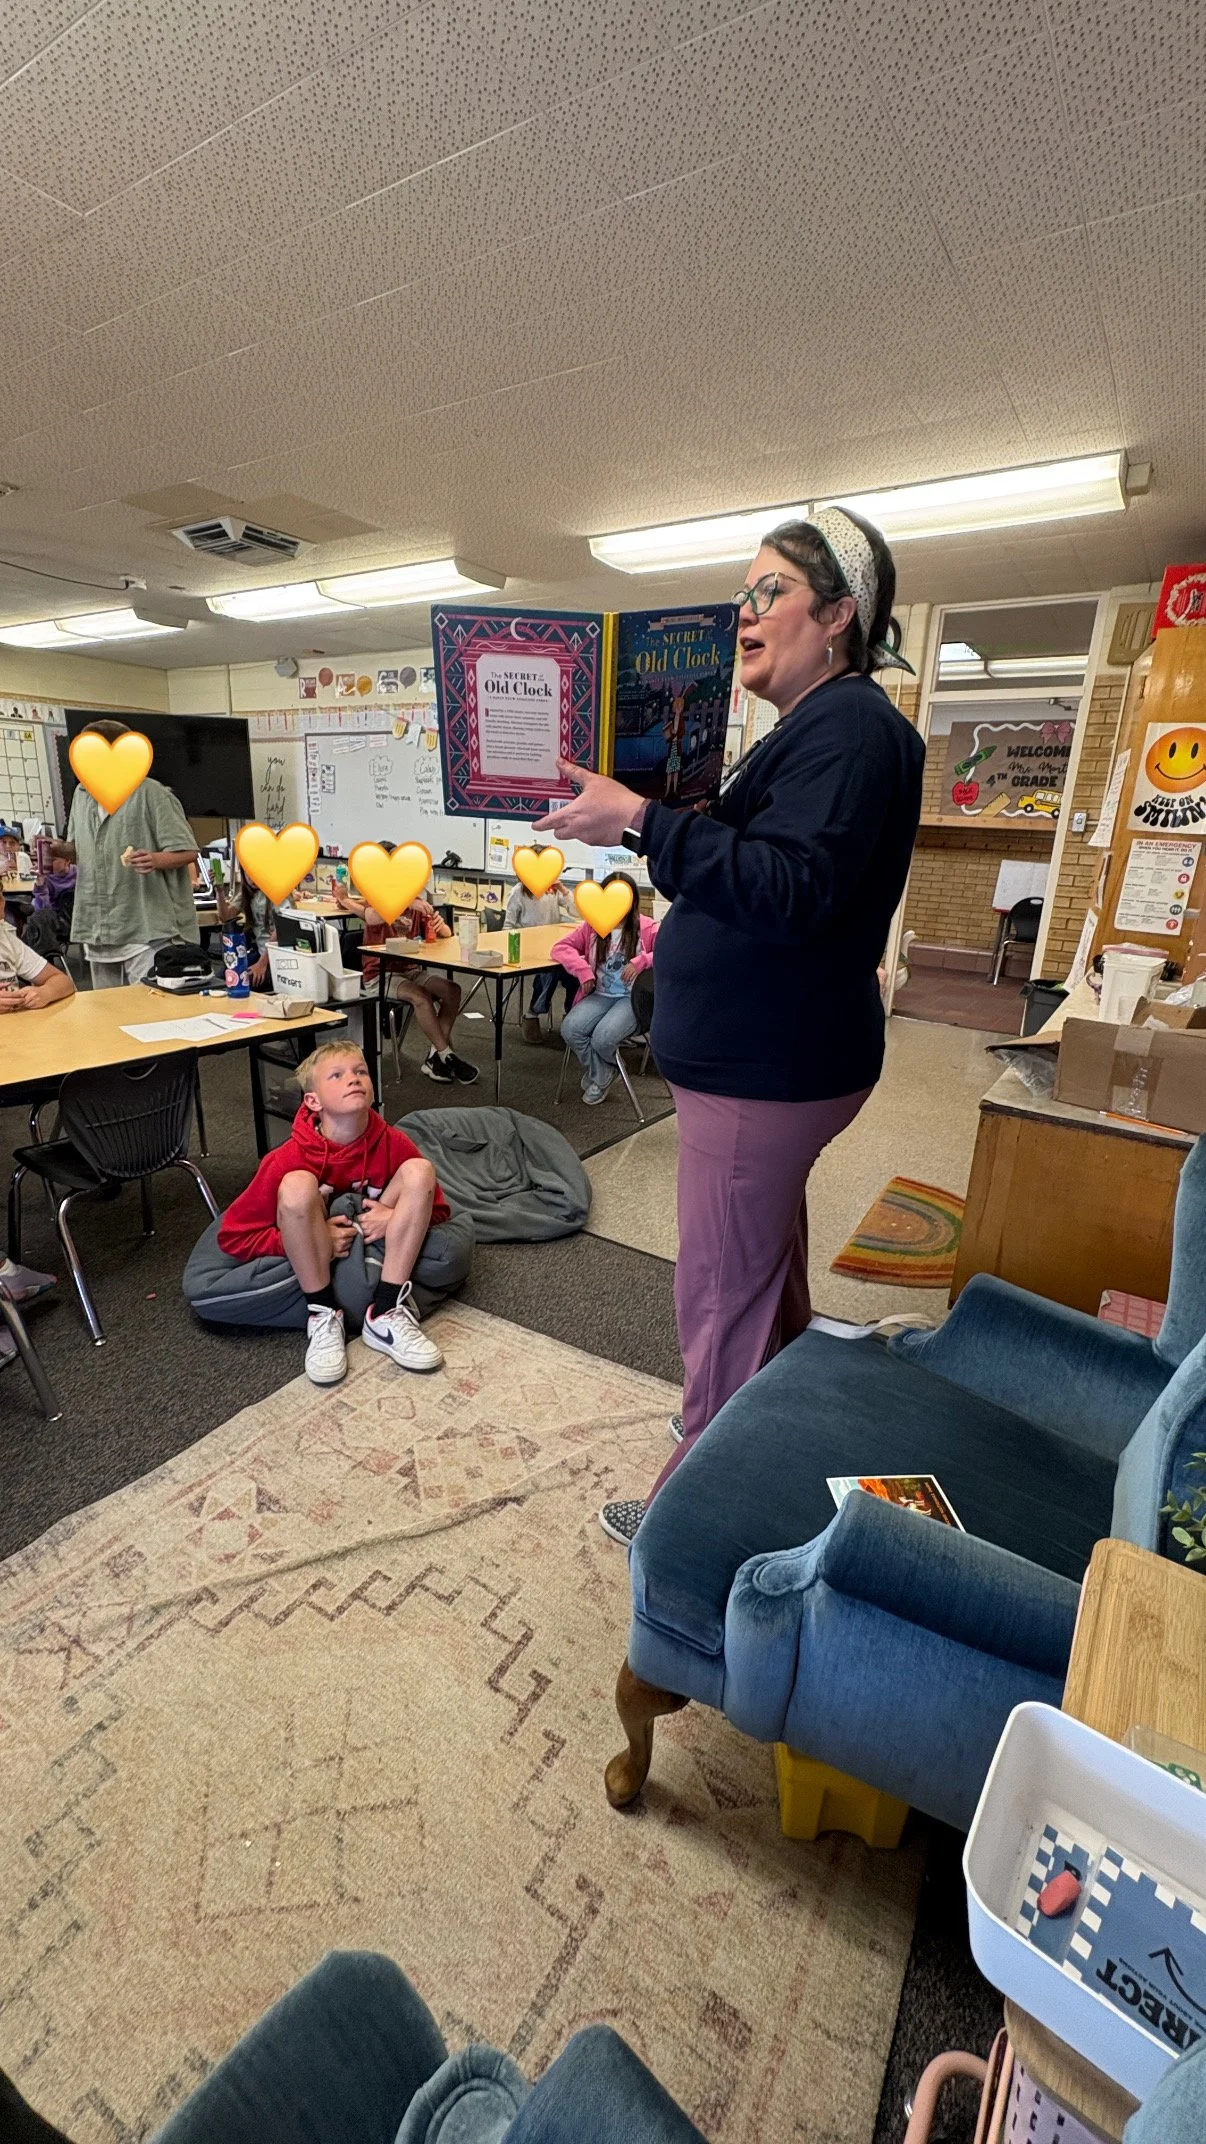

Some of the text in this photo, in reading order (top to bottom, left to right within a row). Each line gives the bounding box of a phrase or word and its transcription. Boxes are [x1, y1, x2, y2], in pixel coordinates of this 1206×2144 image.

[663, 629, 704, 645] SECRET
[635, 643, 720, 675] Old Clock
[504, 672, 538, 681] SECRET
[484, 680, 553, 697] Old Clock
[265, 757, 286, 786] you
[261, 784, 275, 792] can
[1012, 776, 1058, 787] GRADE
[266, 794, 286, 821] hard
[1151, 794, 1194, 808] KEEP ON
[1155, 841, 1197, 849] EMERGENCY
